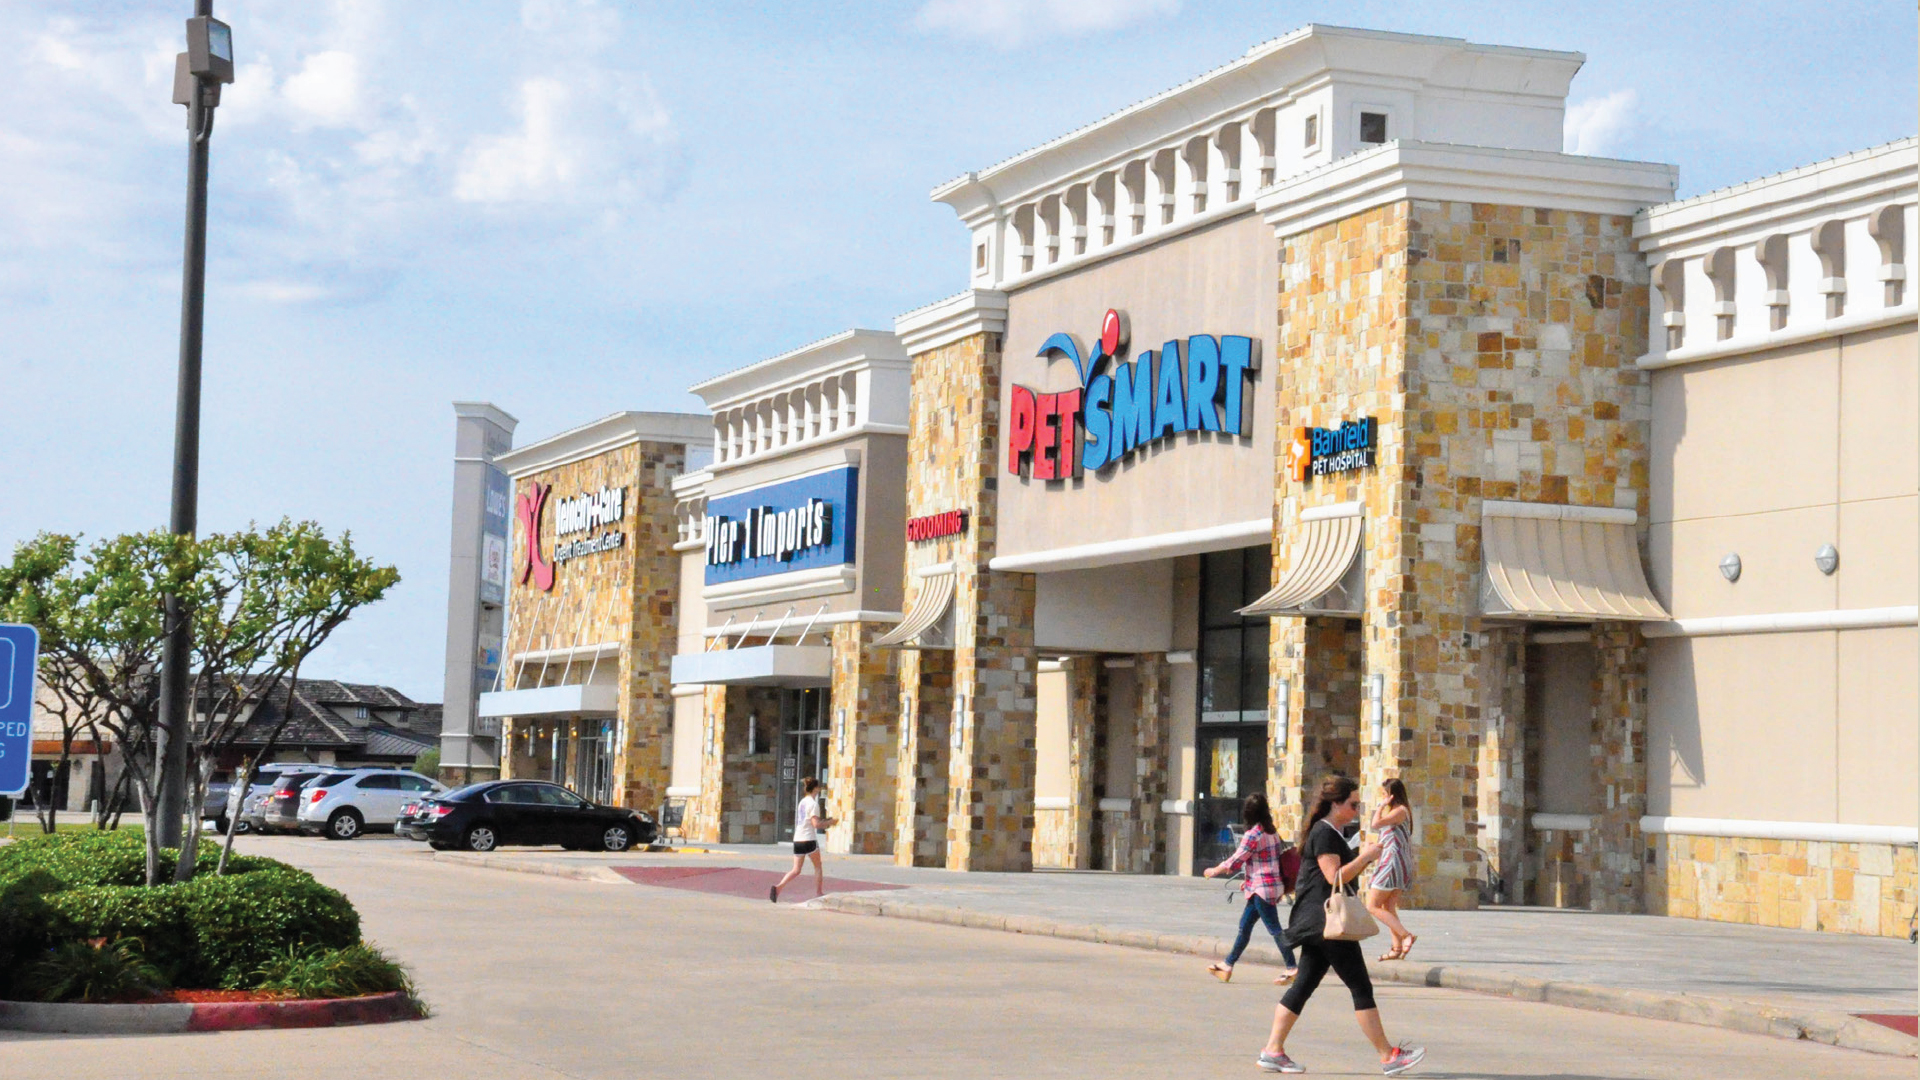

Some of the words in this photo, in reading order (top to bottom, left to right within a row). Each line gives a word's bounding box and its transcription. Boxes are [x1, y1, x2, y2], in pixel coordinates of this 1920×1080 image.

[1312, 418, 1368, 457] Banfield
[1312, 459, 1327, 475] PET
[1329, 451, 1368, 472] HOSPITAL
[705, 516, 738, 566] Pier
[745, 508, 751, 559] 1
[907, 508, 962, 542] GROOMING
[554, 542, 573, 566] Urgent
[573, 536, 601, 558] Treatment
[602, 531, 622, 551] Center
